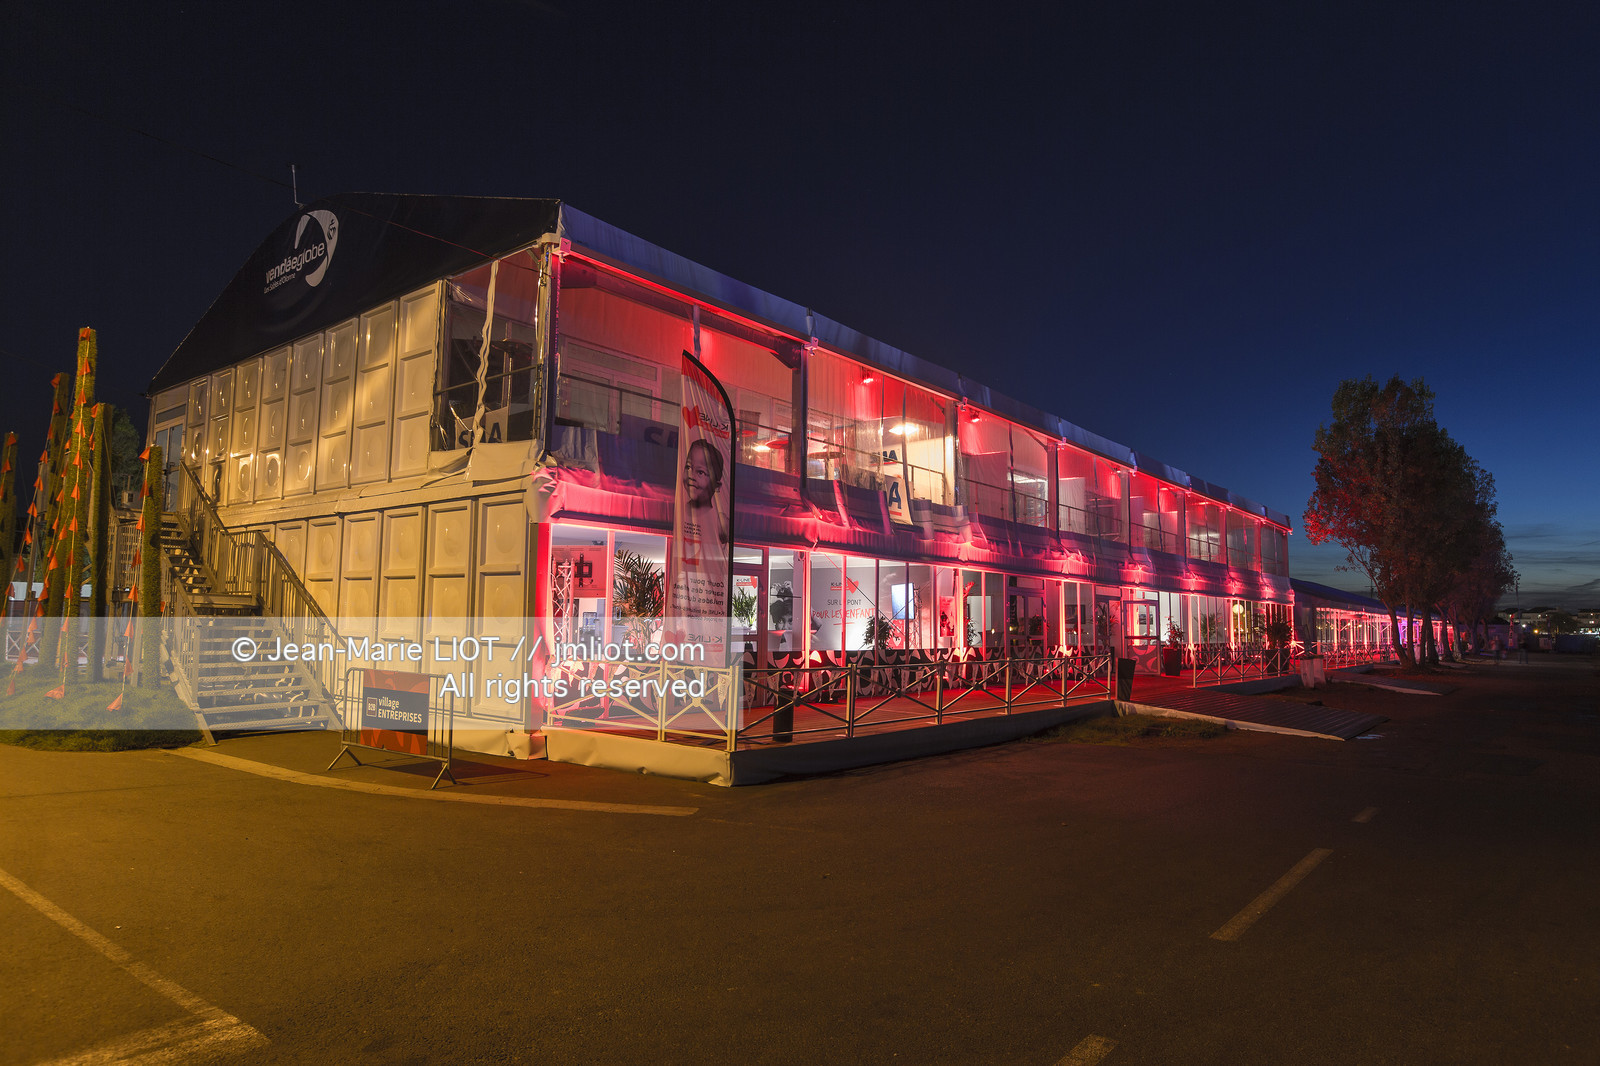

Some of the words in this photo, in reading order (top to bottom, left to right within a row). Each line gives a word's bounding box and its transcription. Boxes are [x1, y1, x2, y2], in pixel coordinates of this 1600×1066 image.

[812, 609, 830, 619] POUR
[845, 607, 876, 619] ENFANT
[379, 696, 400, 710] village
[378, 709, 422, 723] ENTREPRISES
